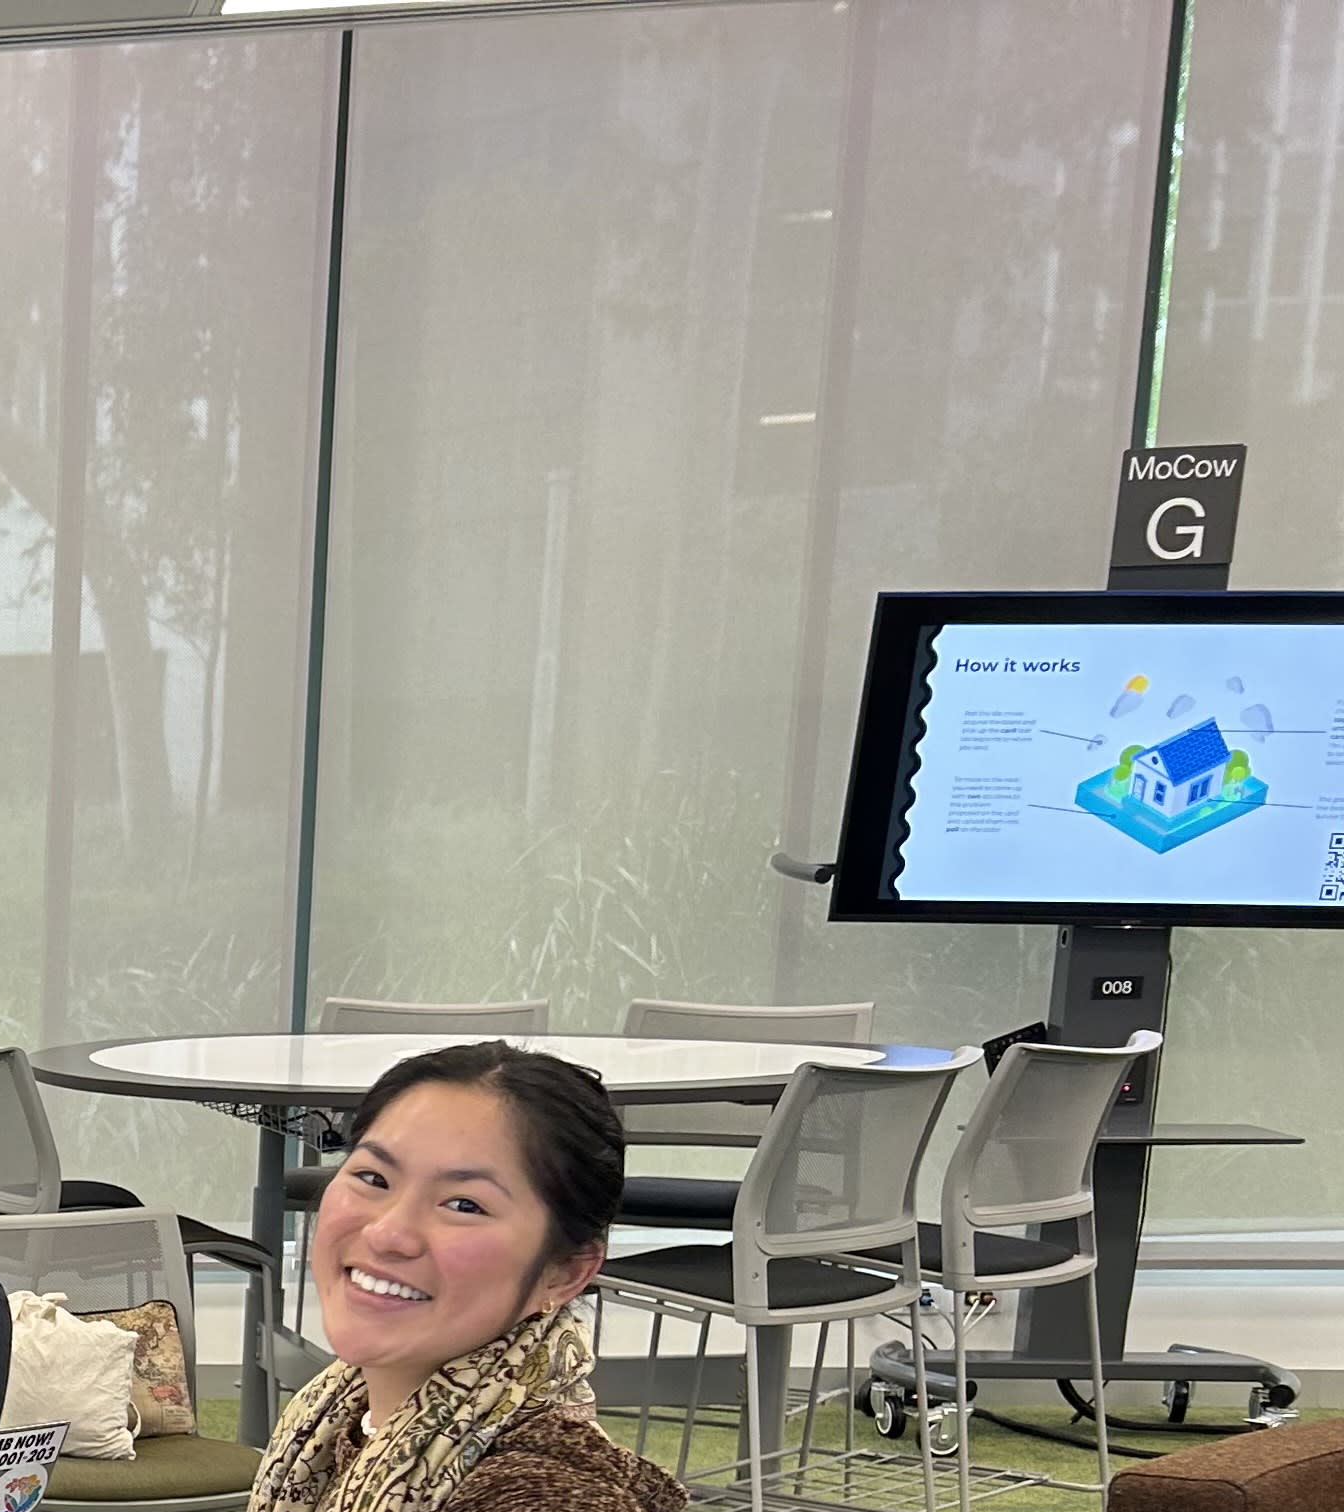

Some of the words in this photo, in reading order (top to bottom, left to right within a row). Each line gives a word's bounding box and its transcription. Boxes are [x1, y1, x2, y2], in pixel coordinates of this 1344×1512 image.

[1127, 455, 1238, 482] MoCow
[1145, 496, 1207, 561] G
[954, 658, 999, 674] How
[1003, 657, 1017, 674] it
[1022, 657, 1081, 674] works
[1101, 979, 1133, 995] 008
[14, 1430, 55, 1449] NOW!
